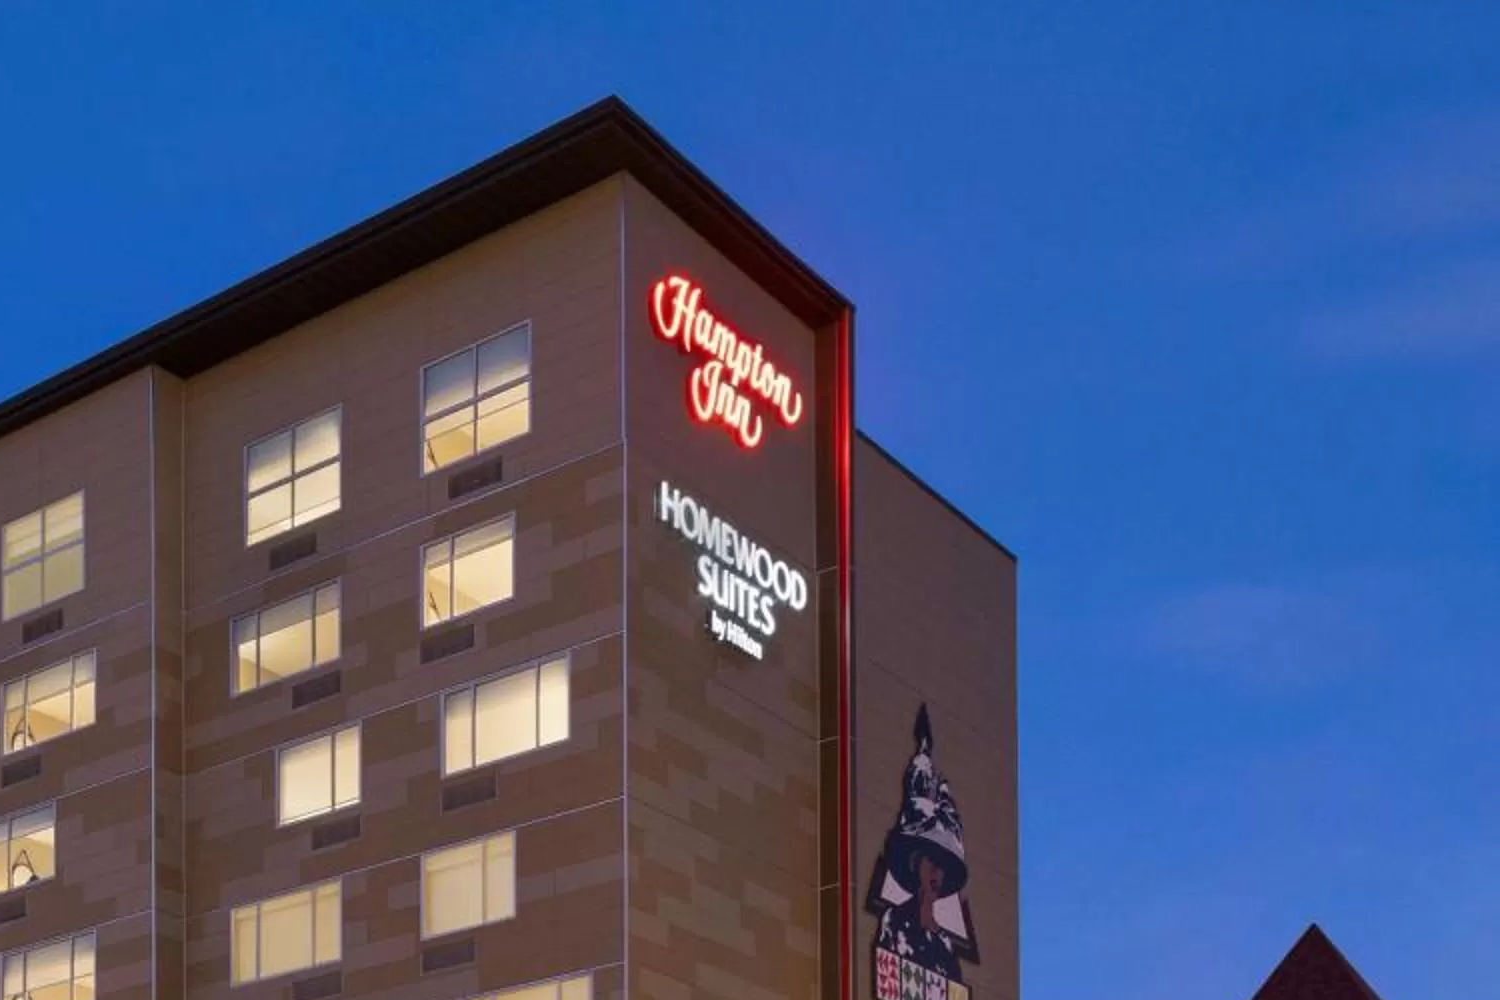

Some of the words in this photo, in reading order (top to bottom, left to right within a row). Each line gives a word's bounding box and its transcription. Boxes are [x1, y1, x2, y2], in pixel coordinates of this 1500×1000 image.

[654, 276, 802, 424] Hampton
[691, 361, 762, 447] Inn
[660, 481, 808, 611] HOMEWOOD
[697, 555, 776, 635] SUITES
[711, 610, 726, 640] by
